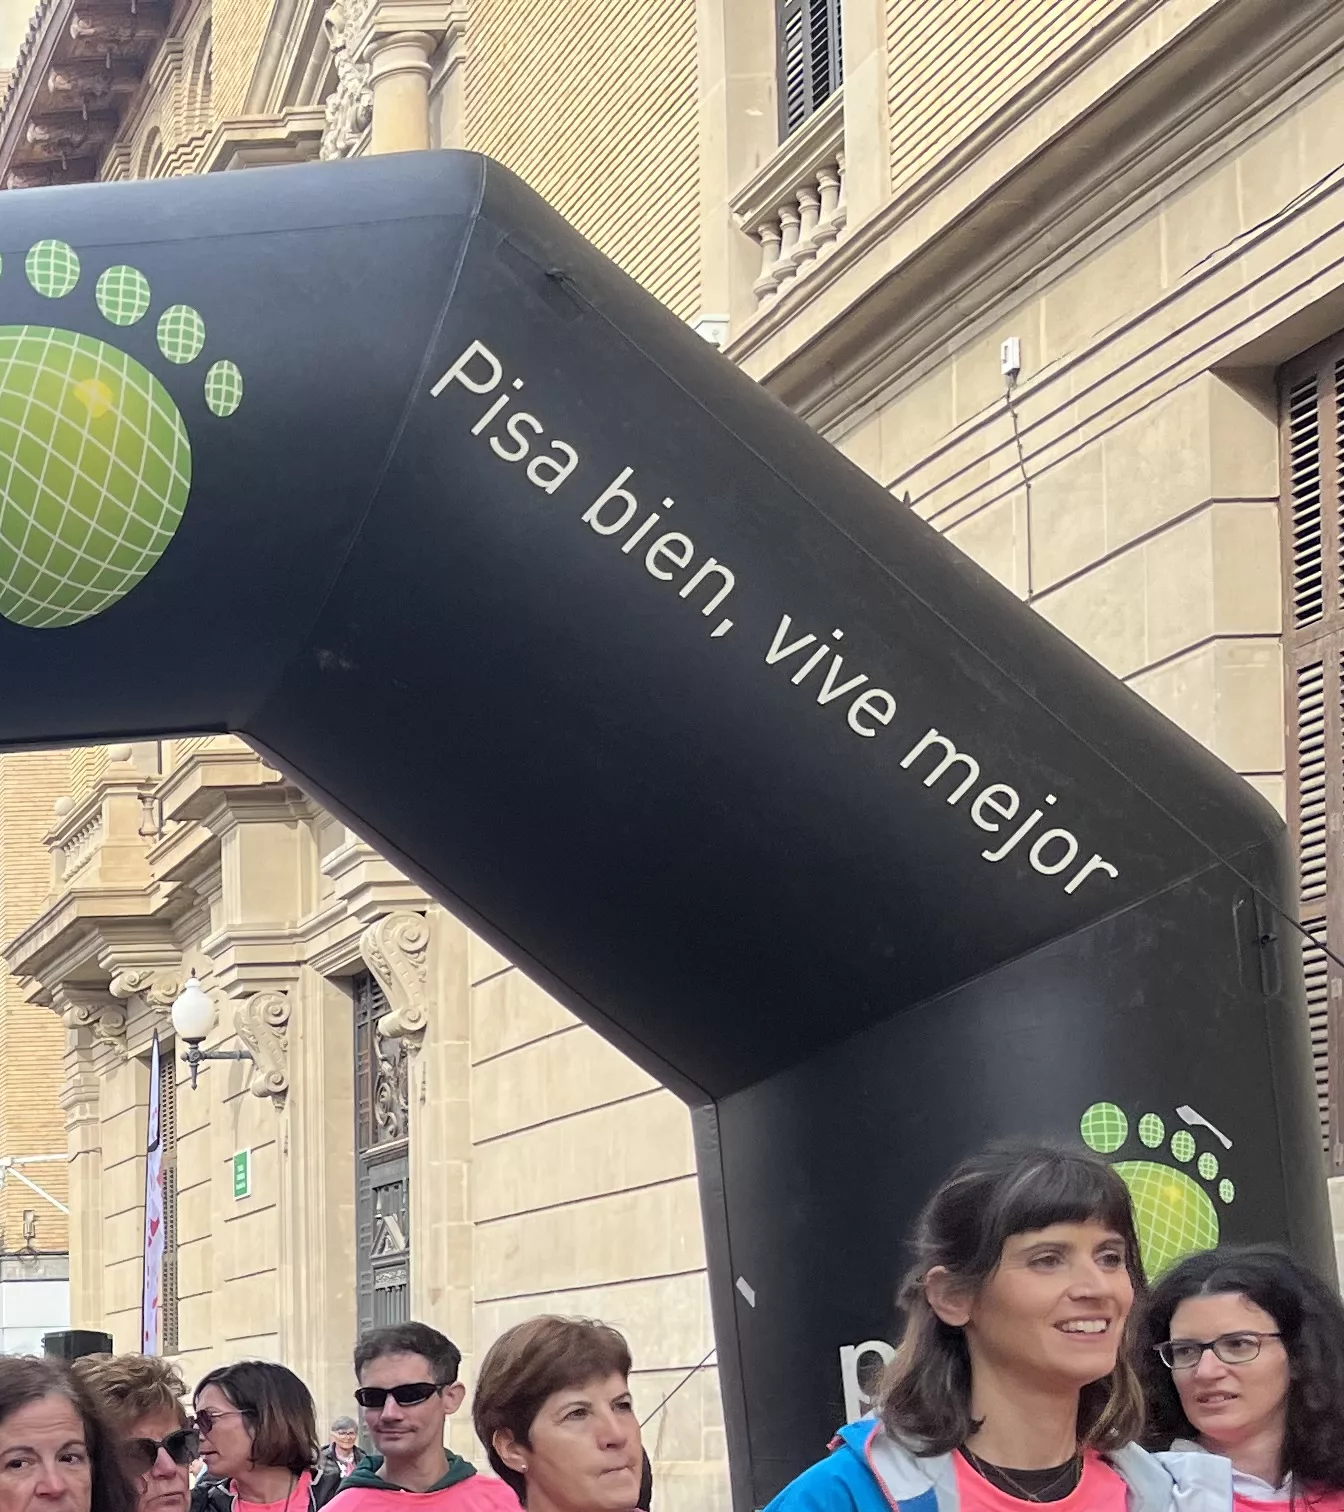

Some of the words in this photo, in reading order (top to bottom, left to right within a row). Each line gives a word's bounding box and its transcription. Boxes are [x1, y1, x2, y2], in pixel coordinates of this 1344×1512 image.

[428, 339, 580, 495] Pisa
[581, 466, 736, 638] bien,
[764, 614, 898, 737] vive
[899, 728, 1119, 895] mejor
